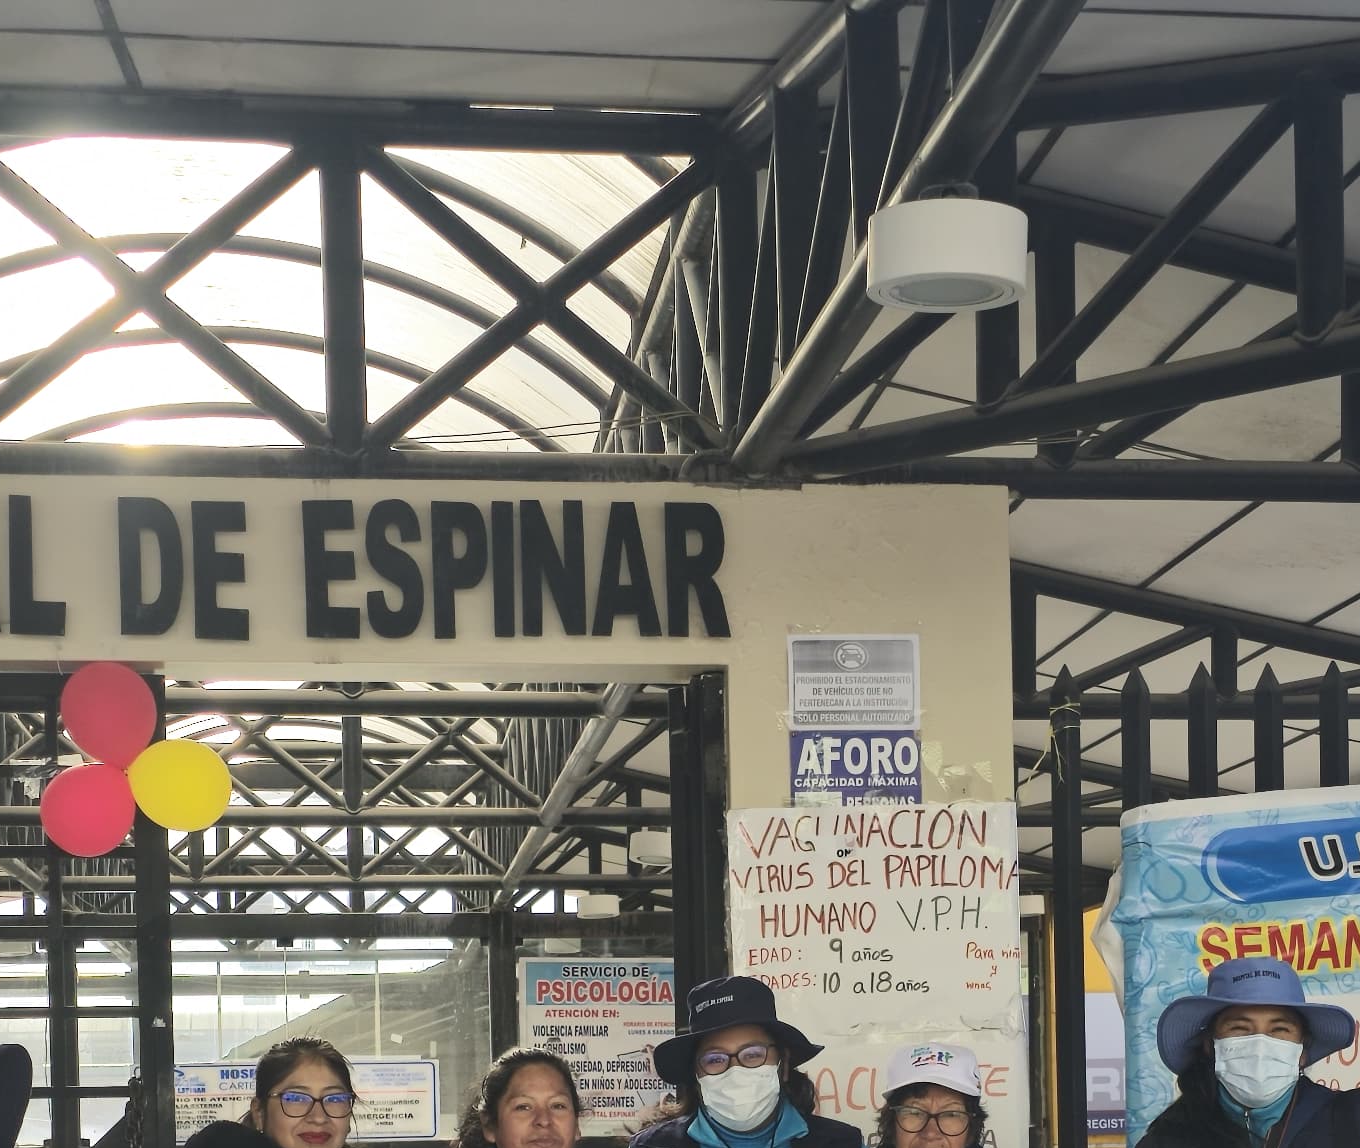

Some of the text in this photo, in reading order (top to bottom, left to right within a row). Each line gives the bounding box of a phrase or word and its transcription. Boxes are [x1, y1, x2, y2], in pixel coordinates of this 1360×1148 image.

[117, 496, 250, 640] DE
[302, 497, 731, 640] ESPINAR
[797, 737, 919, 775] AFORO
[794, 776, 917, 787] CAPACIDAD MÁXIMA
[732, 855, 1019, 893] VIRUS DEL PAPILOMA
[760, 901, 877, 938] HUMANO
[829, 938, 842, 963] 9
[851, 949, 893, 962] años
[563, 966, 649, 977] SERVICIO DE
[750, 972, 817, 989] DADES:
[823, 971, 840, 993] 10
[895, 980, 930, 993] años
[537, 977, 673, 1003] PSICOLOGÍA
[545, 1009, 620, 1018] ATENCIÓN EN:
[533, 1025, 608, 1037] VIOLENCIA FAMILIAR
[580, 1079, 589, 1089] EN
[617, 1079, 622, 1089] Y
[1087, 1119, 1125, 1129] REGIST
